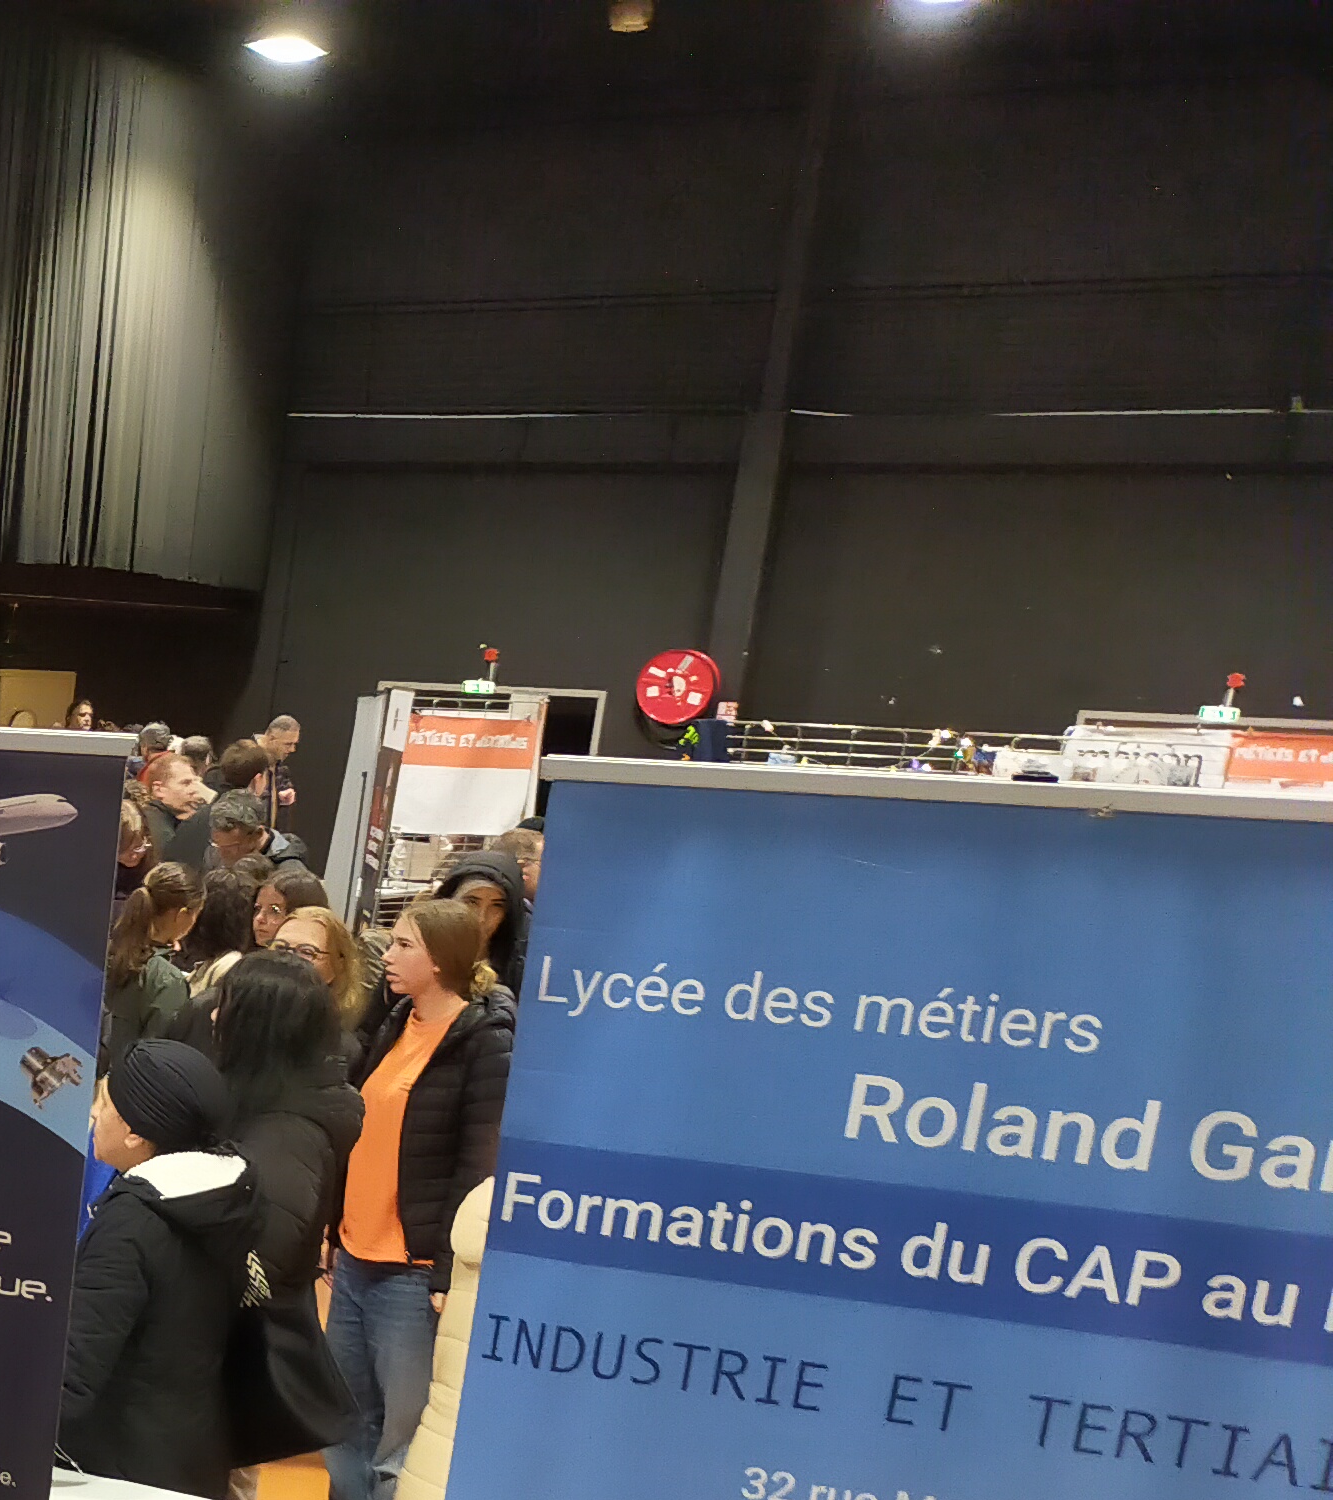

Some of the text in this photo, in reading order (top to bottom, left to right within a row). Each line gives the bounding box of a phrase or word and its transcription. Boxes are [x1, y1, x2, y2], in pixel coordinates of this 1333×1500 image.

[538, 955, 1103, 1054] Lycée des métiers
[844, 1073, 1162, 1172] Roland
[501, 1171, 879, 1271] Formations
[900, 1222, 991, 1285] du
[1015, 1237, 1183, 1307] CAP
[1201, 1273, 1300, 1328] au
[481, 1313, 829, 1412] INDUSTRIE
[885, 1373, 973, 1432] ET
